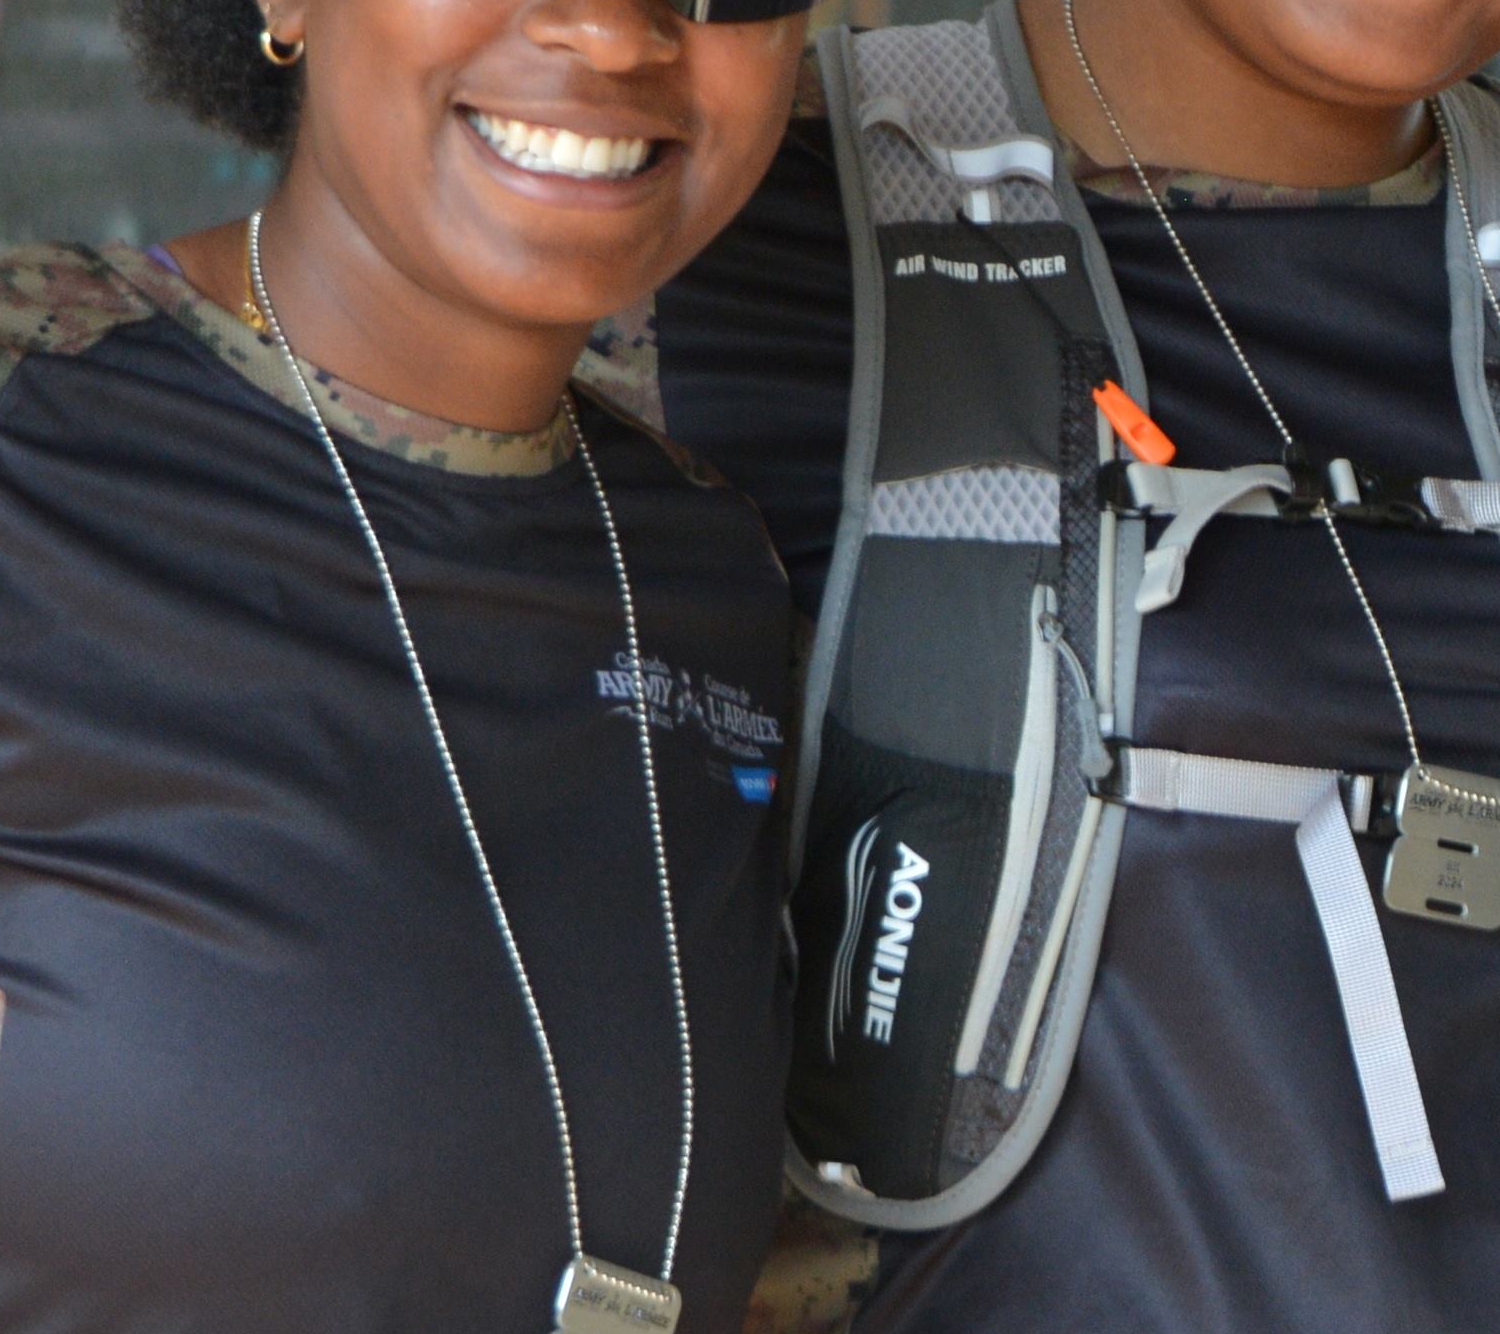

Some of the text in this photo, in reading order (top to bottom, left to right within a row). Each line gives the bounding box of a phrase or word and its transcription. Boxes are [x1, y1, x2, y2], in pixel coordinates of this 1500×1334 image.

[895, 254, 925, 276] AIR
[932, 255, 978, 282] WIND
[863, 841, 930, 1045] AONIJIE
